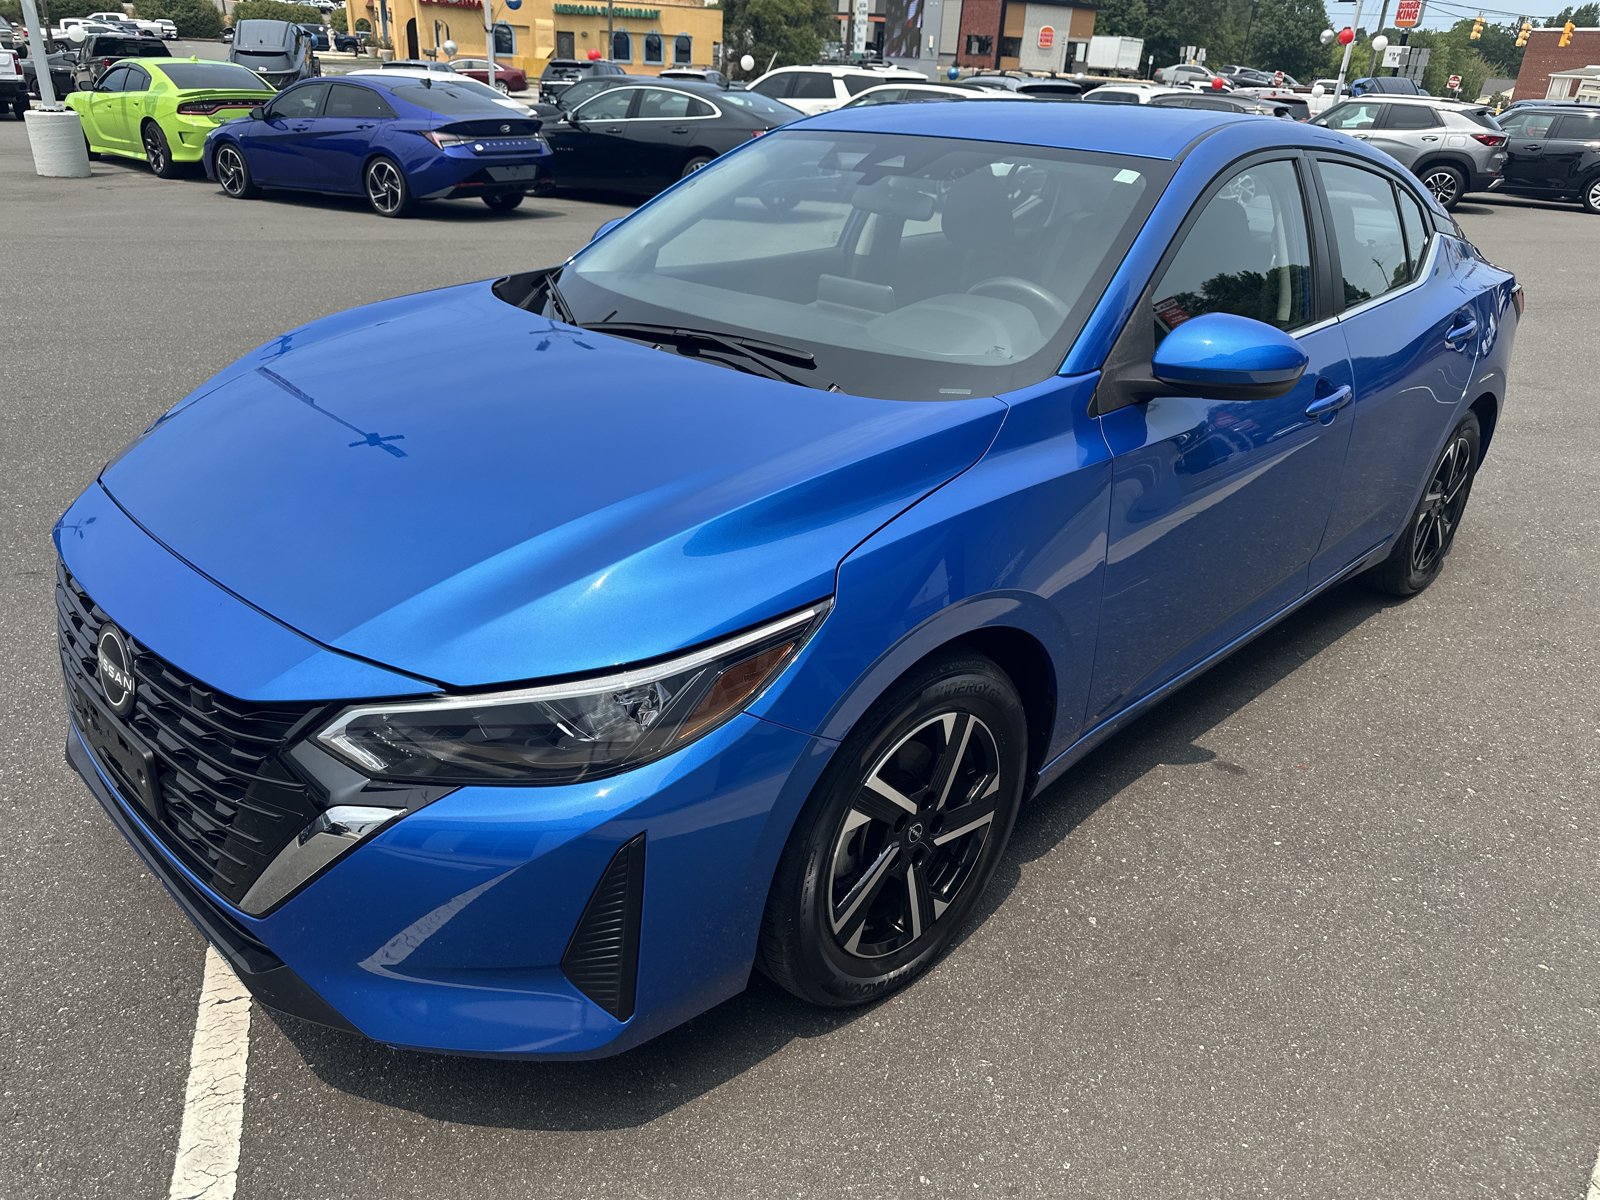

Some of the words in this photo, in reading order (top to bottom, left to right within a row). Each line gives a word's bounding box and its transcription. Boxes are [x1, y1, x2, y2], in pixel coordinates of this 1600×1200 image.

[554, 3, 598, 16] MEXICAN
[600, 6, 661, 20] RSTAURANT
[1395, 10, 1419, 20] KING
